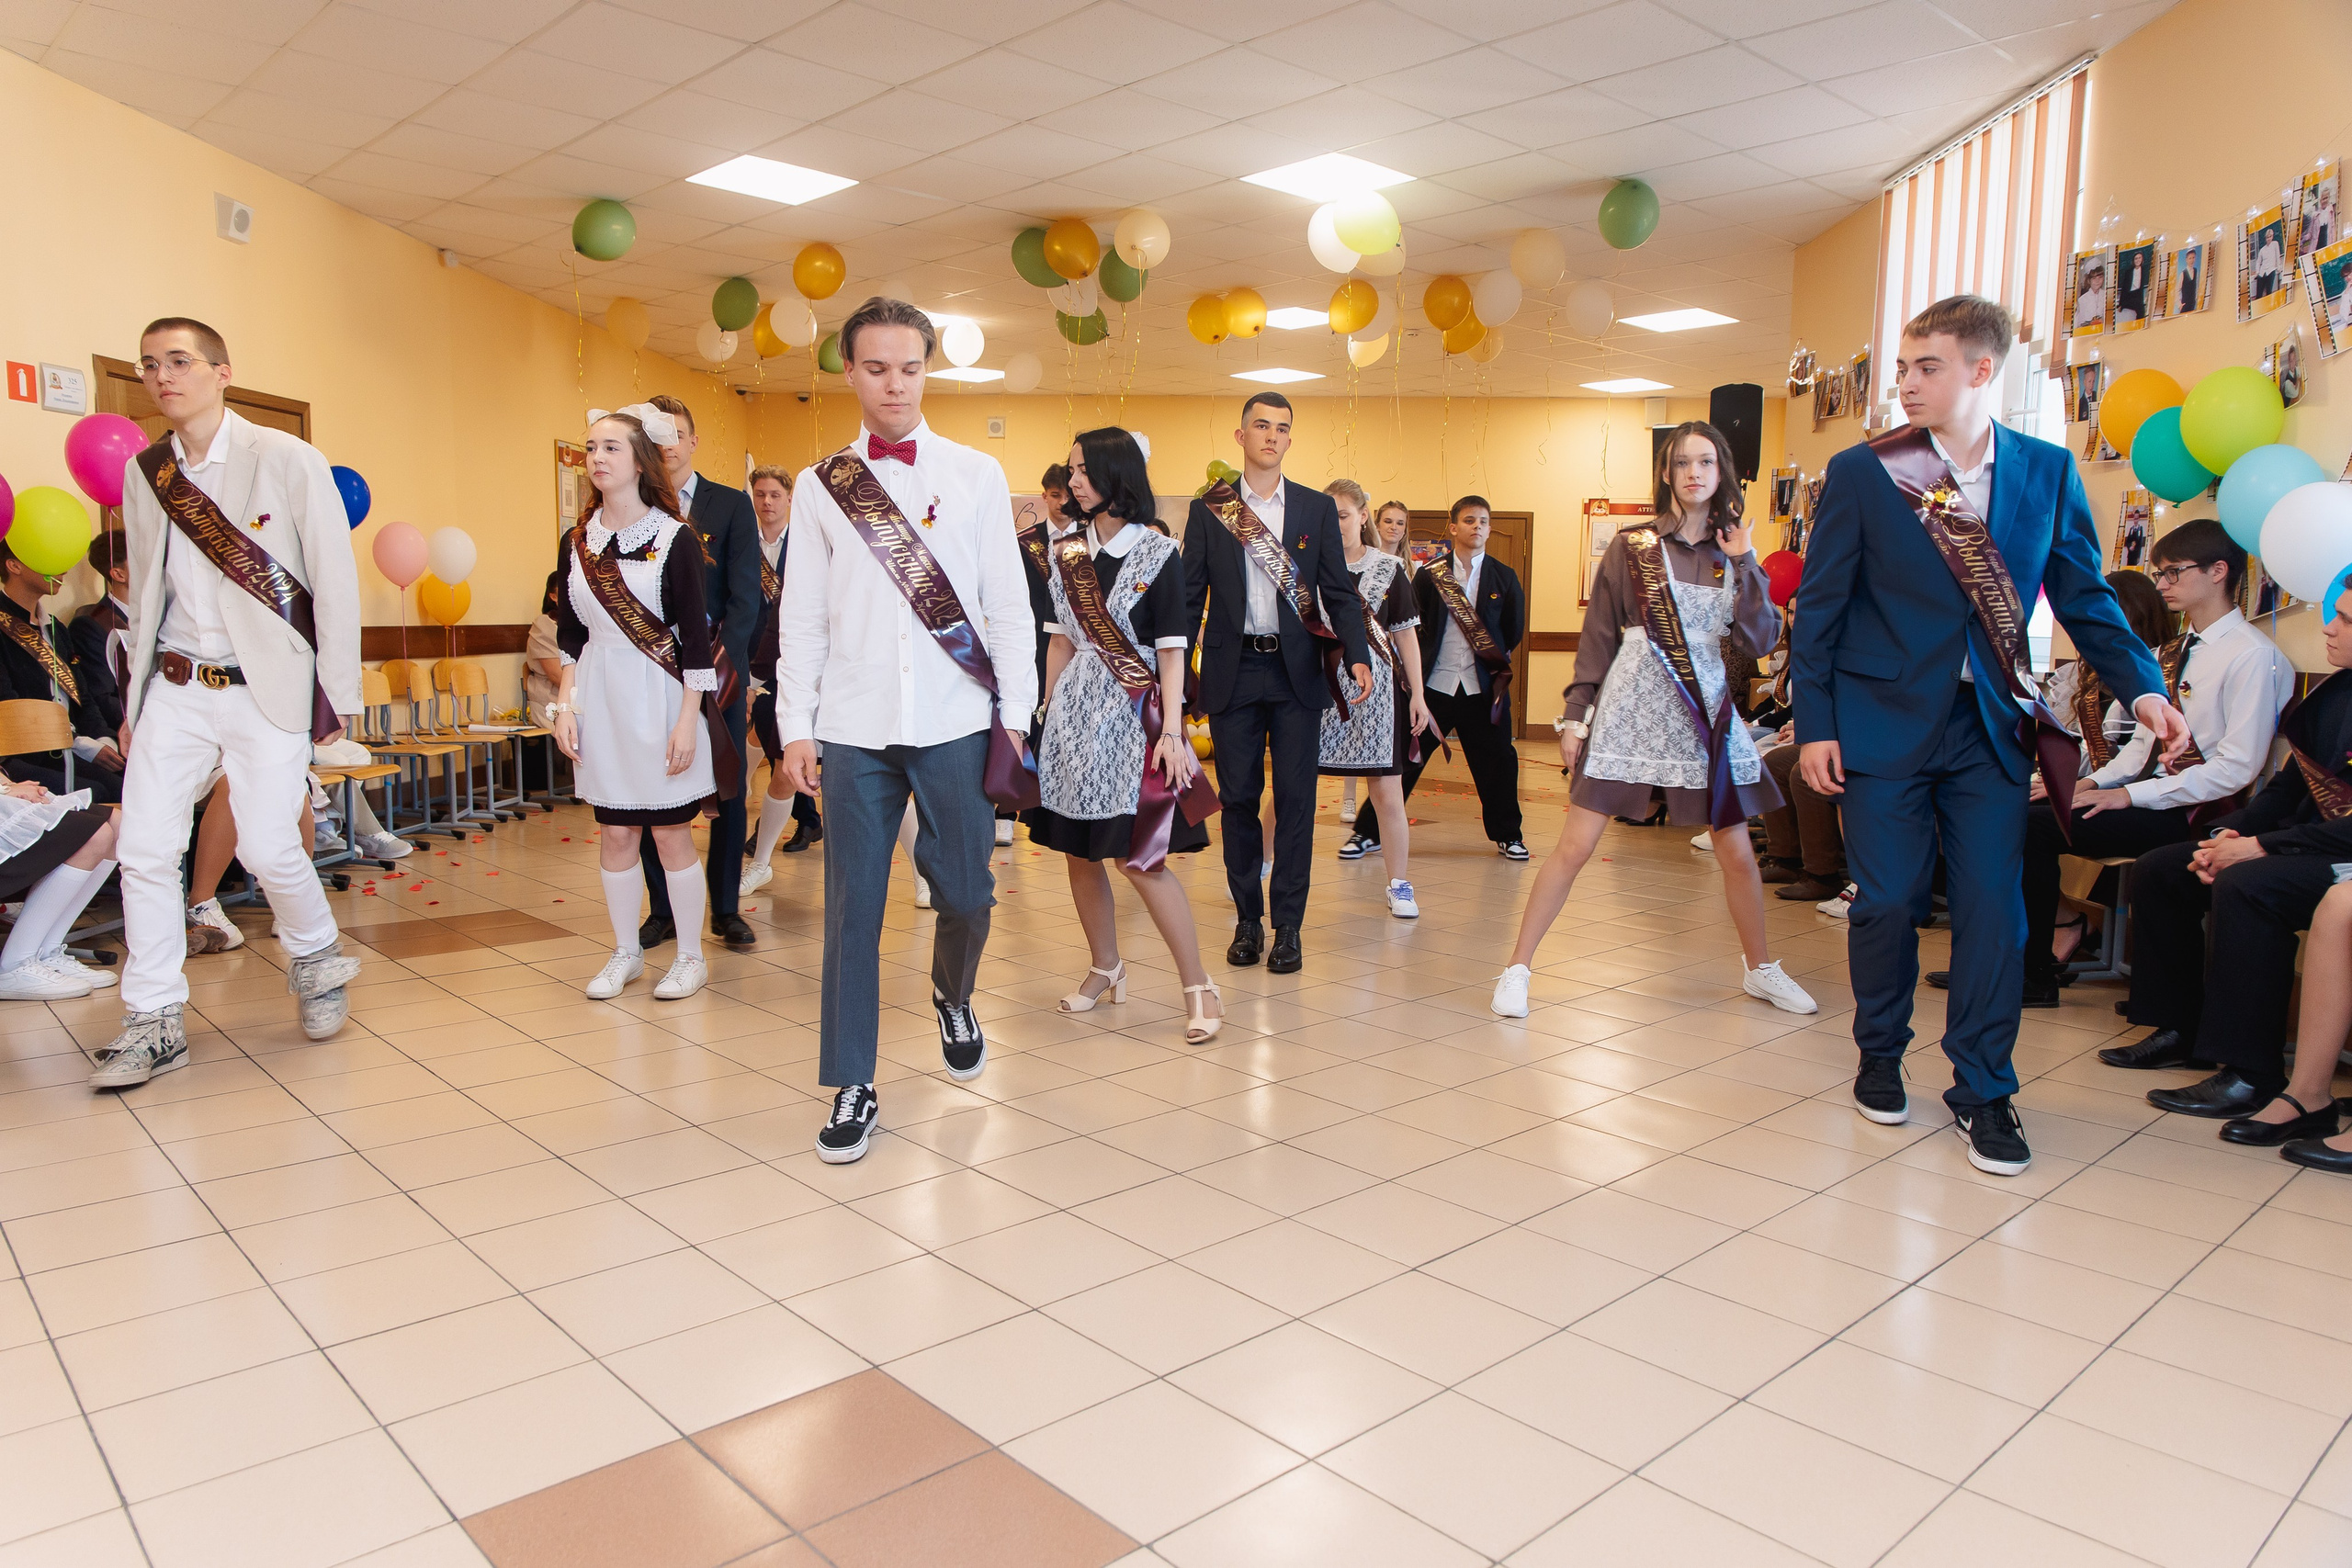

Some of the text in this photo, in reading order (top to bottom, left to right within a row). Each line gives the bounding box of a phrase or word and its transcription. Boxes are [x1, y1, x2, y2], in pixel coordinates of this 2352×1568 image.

[167, 478, 302, 606] Выпускник 2024
[848, 480, 966, 635] Выпускник 2024
[910, 542, 938, 577] Максим
[1233, 512, 1297, 588] Выпускник
[1289, 583, 1313, 614] 2024
[1941, 512, 2017, 637] Выпускник
[1981, 546, 2005, 574] Егоров
[1997, 573, 2018, 611] Никита
[593, 559, 660, 643] Выпускница
[1072, 565, 1125, 658] Выпускница
[1439, 573, 1477, 631] Выпускник
[1469, 627, 1495, 650] 2024
[1637, 549, 1677, 647] Выпускница
